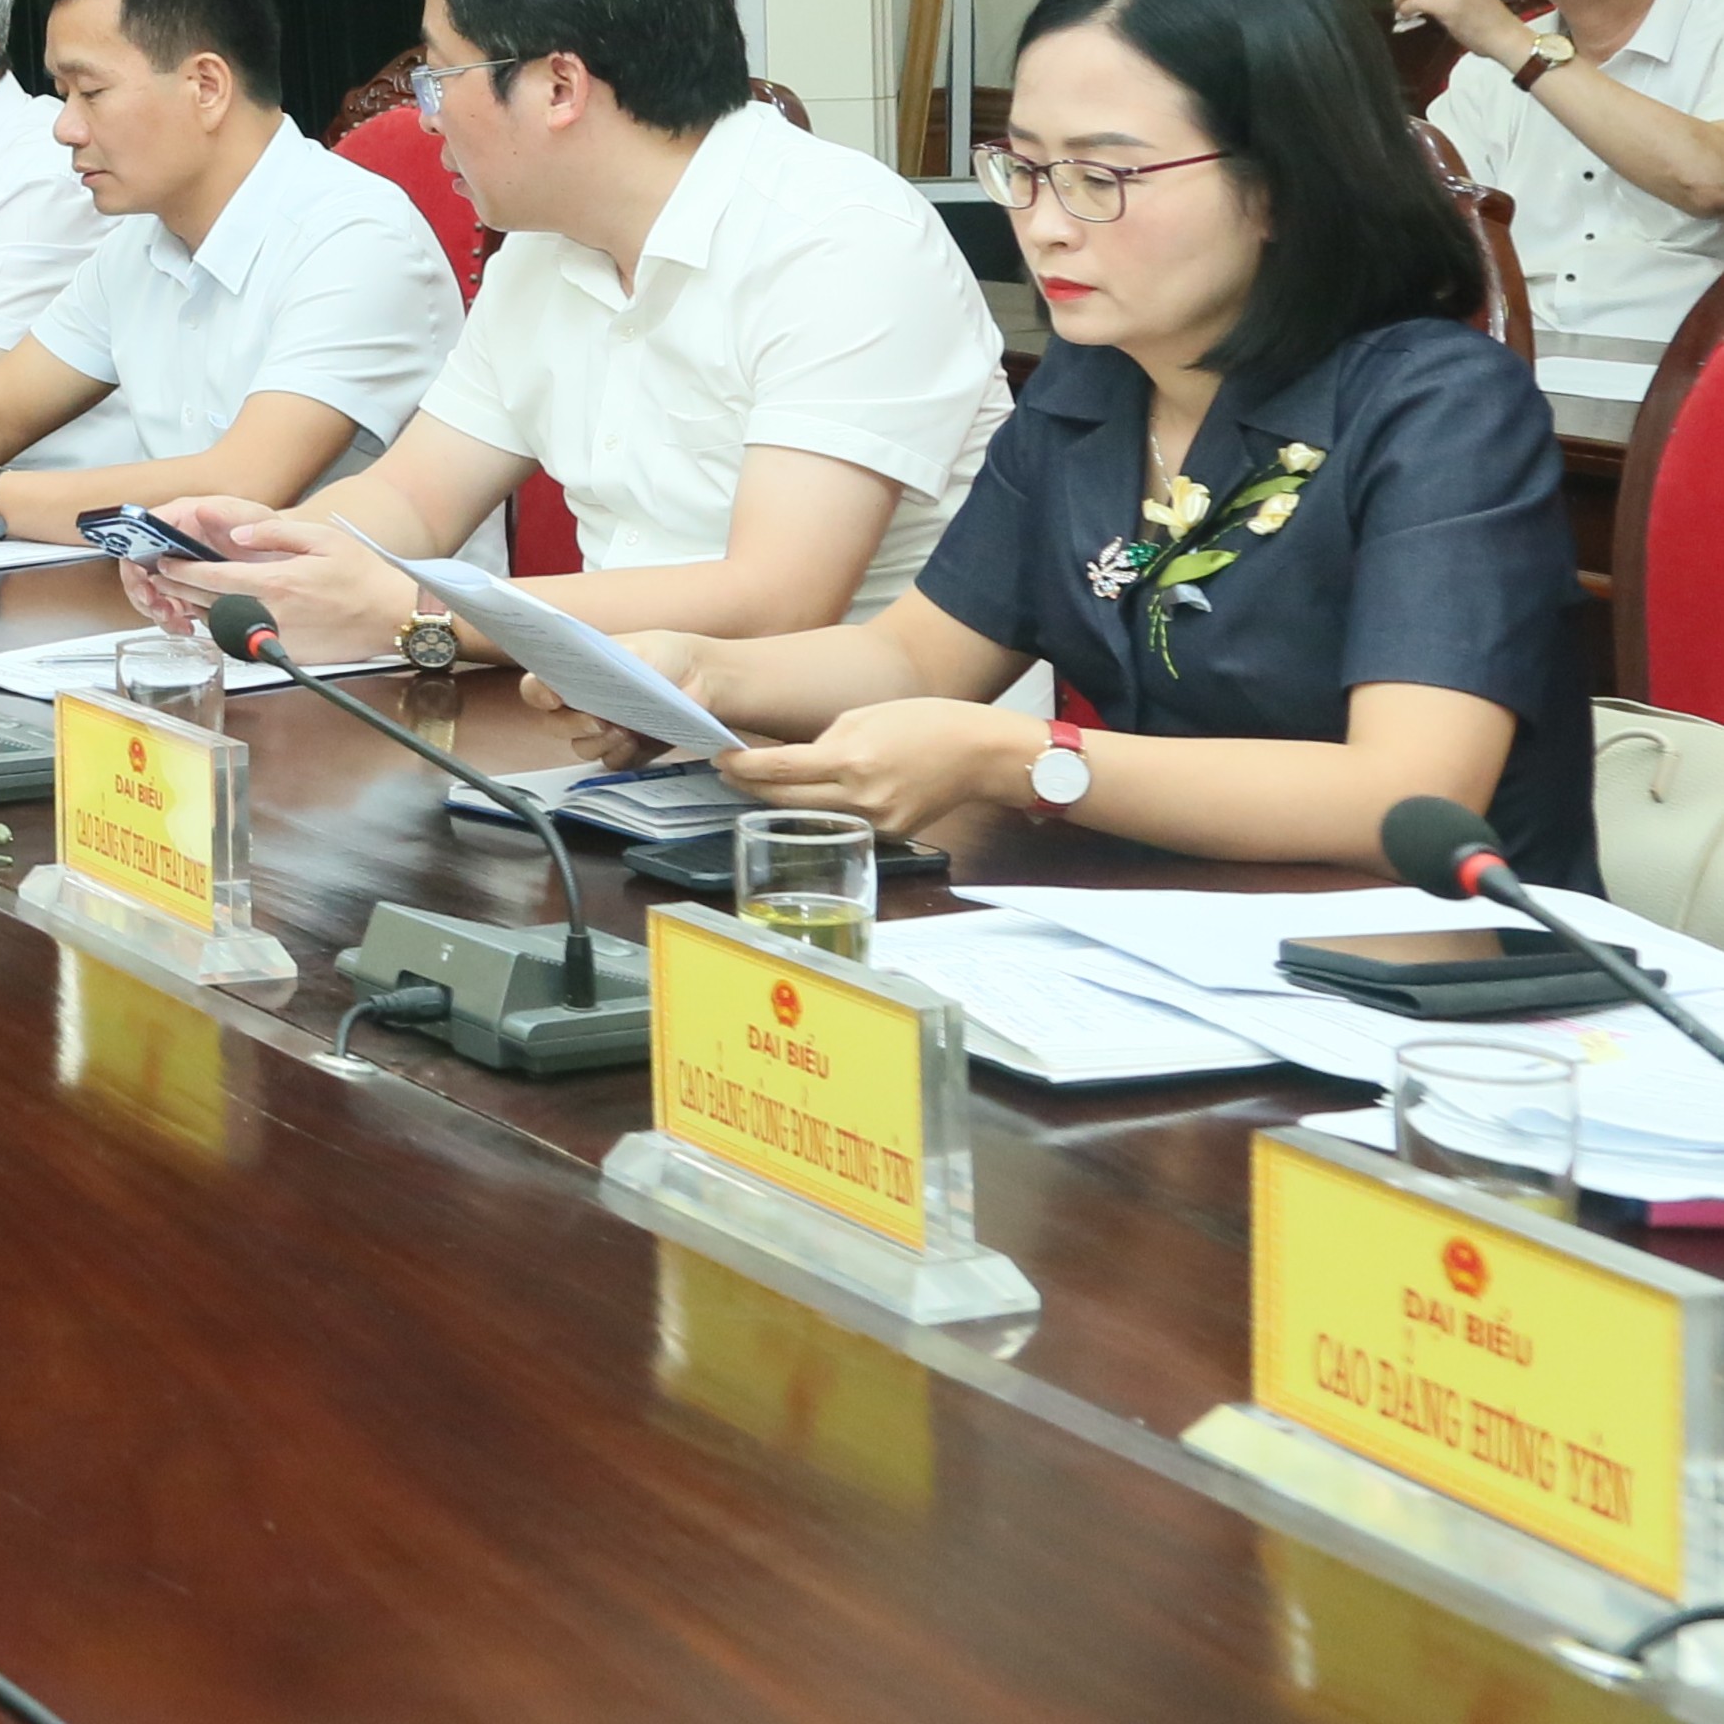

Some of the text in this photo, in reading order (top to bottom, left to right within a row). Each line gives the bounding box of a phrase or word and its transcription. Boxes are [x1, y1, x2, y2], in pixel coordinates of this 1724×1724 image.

[114, 773, 164, 812] ĐẠI BIỂU
[746, 1023, 829, 1079] ĐẠI BIỂU
[677, 1059, 704, 1115] CAO
[1402, 1286, 1534, 1369] ĐẠI BIỂU
[1312, 1324, 1634, 1528] CAO ĐẲNG HƯNG YÊN
